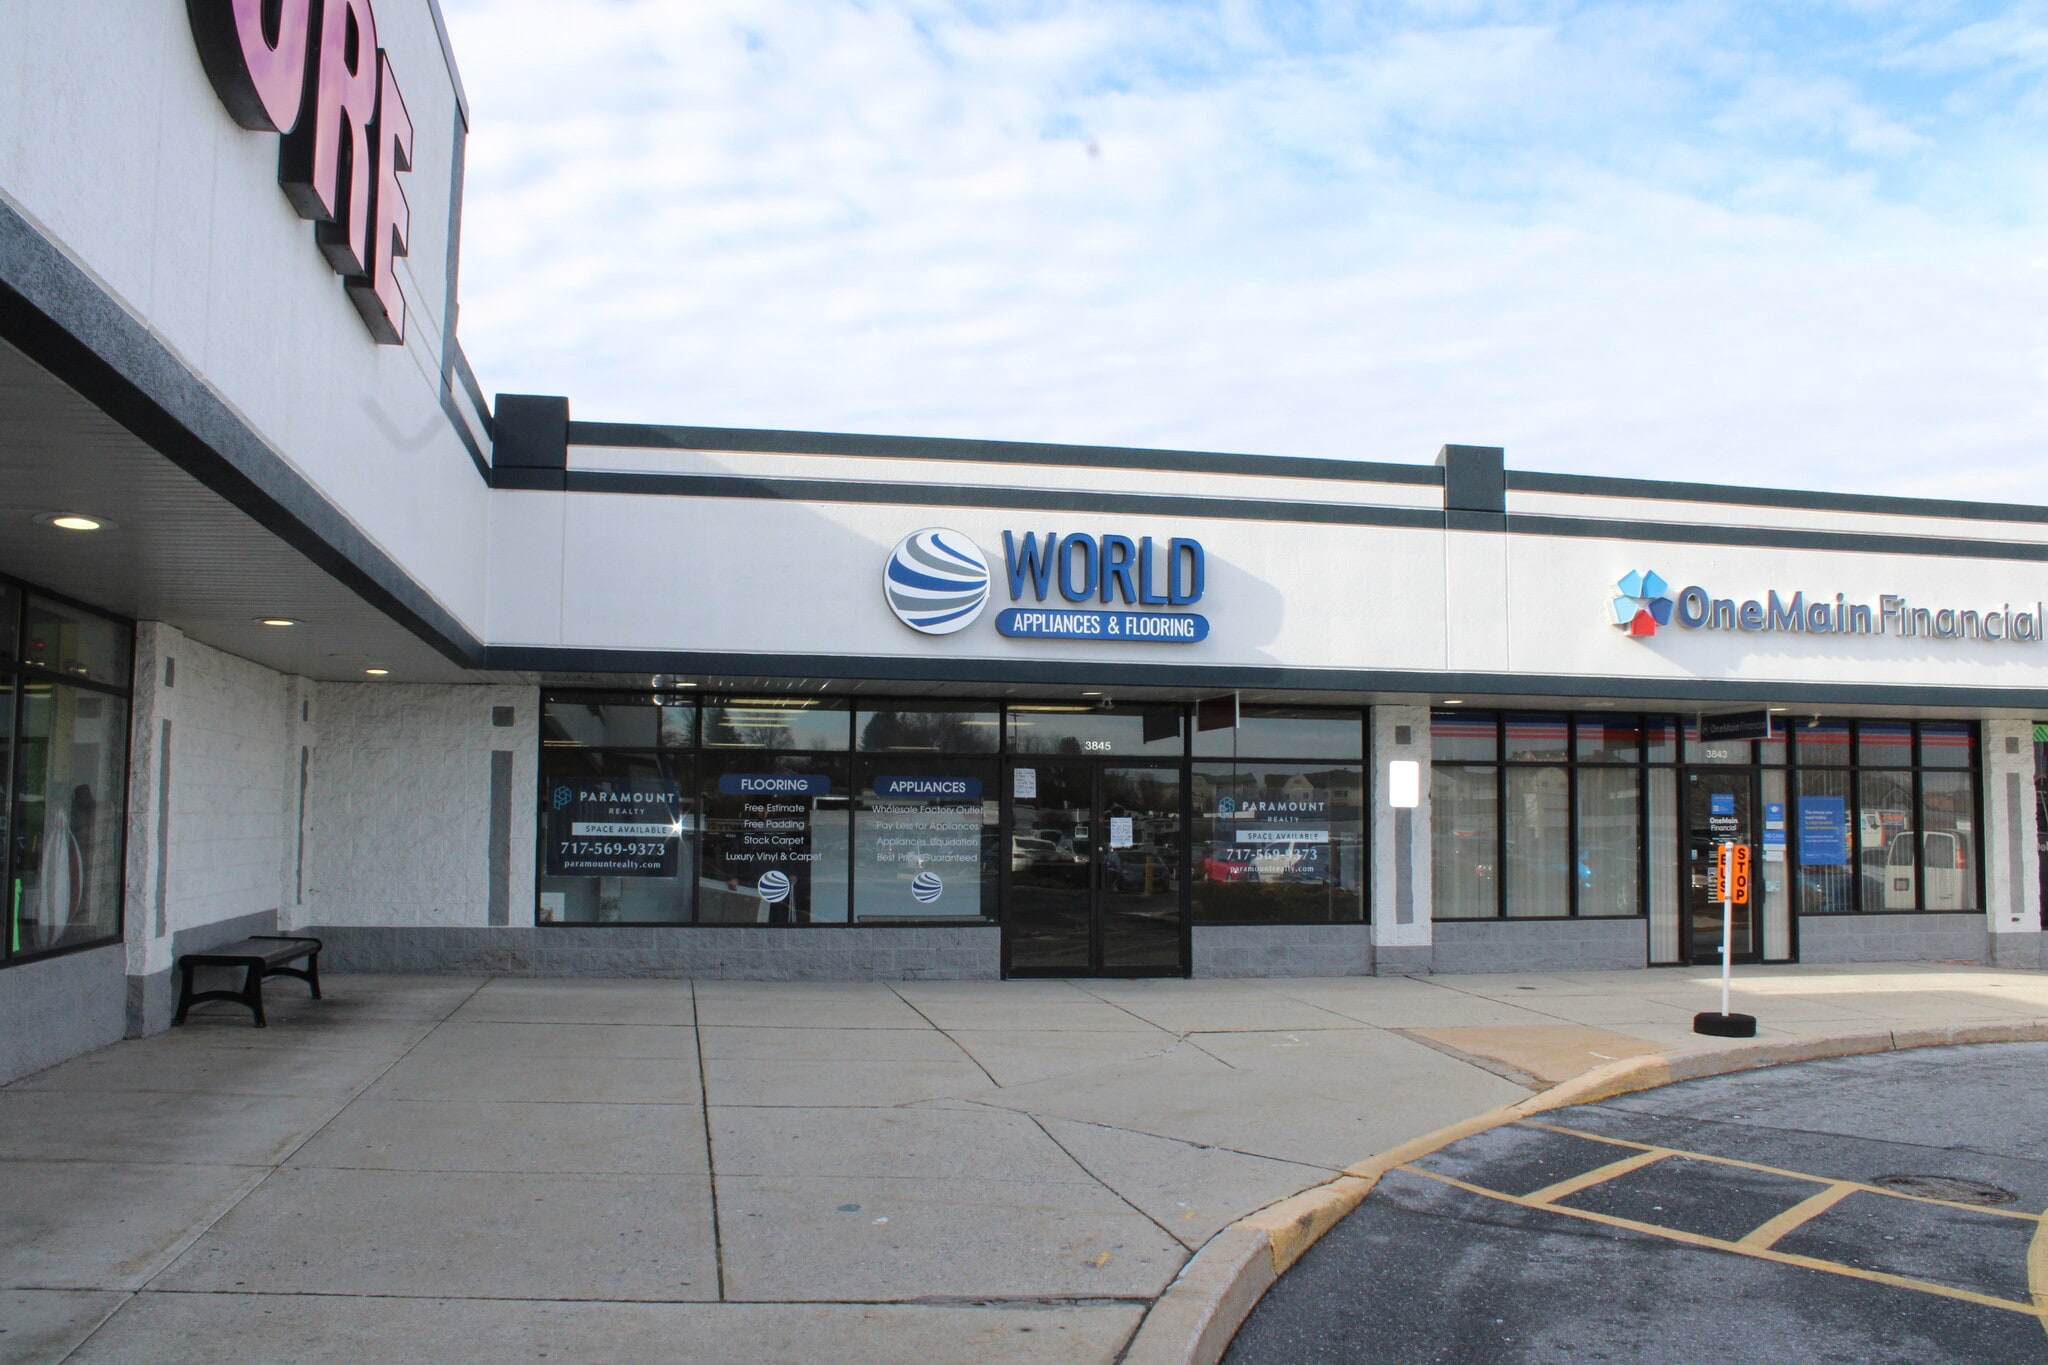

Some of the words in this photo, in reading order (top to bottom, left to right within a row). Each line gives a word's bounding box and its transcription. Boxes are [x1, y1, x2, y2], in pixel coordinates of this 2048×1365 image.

[1002, 529, 1205, 606] WORLD
[1013, 612, 1100, 635] APPLIANCES
[1108, 616, 1120, 635] &
[1126, 617, 1194, 638] FLOORING
[1085, 741, 1111, 751] 3845
[1706, 749, 1728, 758] 3843
[741, 779, 808, 791] FLOORING
[889, 781, 966, 793] APPLIANCES
[580, 791, 675, 803] PARAMOUNT
[608, 807, 645, 815] REALTY
[744, 803, 764, 812] Free
[767, 803, 805, 813] Estimate
[872, 805, 918, 814] Wholesale
[920, 806, 955, 815] Factory
[956, 806, 984, 814] Outlet
[1242, 801, 1325, 812] PARAMOUNT
[585, 825, 614, 833] SPACE
[617, 825, 667, 834] AVAILABLE
[744, 819, 764, 829] Free
[766, 819, 805, 831] Padding
[876, 822, 894, 832] Pay
[895, 822, 914, 830] Less
[915, 822, 927, 830] for
[929, 822, 979, 832] Appliances
[744, 836, 770, 846] Stock
[771, 836, 804, 846] Carpet
[1247, 832, 1273, 840] SPACE
[1275, 832, 1319, 840] AVAILABLE
[877, 838, 927, 848] Appliances
[560, 842, 665, 856] 717-569-9373
[725, 852, 753, 862] Luxury
[756, 852, 778, 862] Vinyl
[780, 853, 787, 861] &
[789, 852, 822, 863] Carpet
[877, 853, 895, 862] Best
[921, 853, 978, 862] Guaranteed
[1226, 849, 1318, 861] 717-569-9373
[564, 861, 661, 869] paramountrealty.com
[1230, 865, 1314, 874] paramountrealty.com
[1736, 847, 1747, 901] STOP
